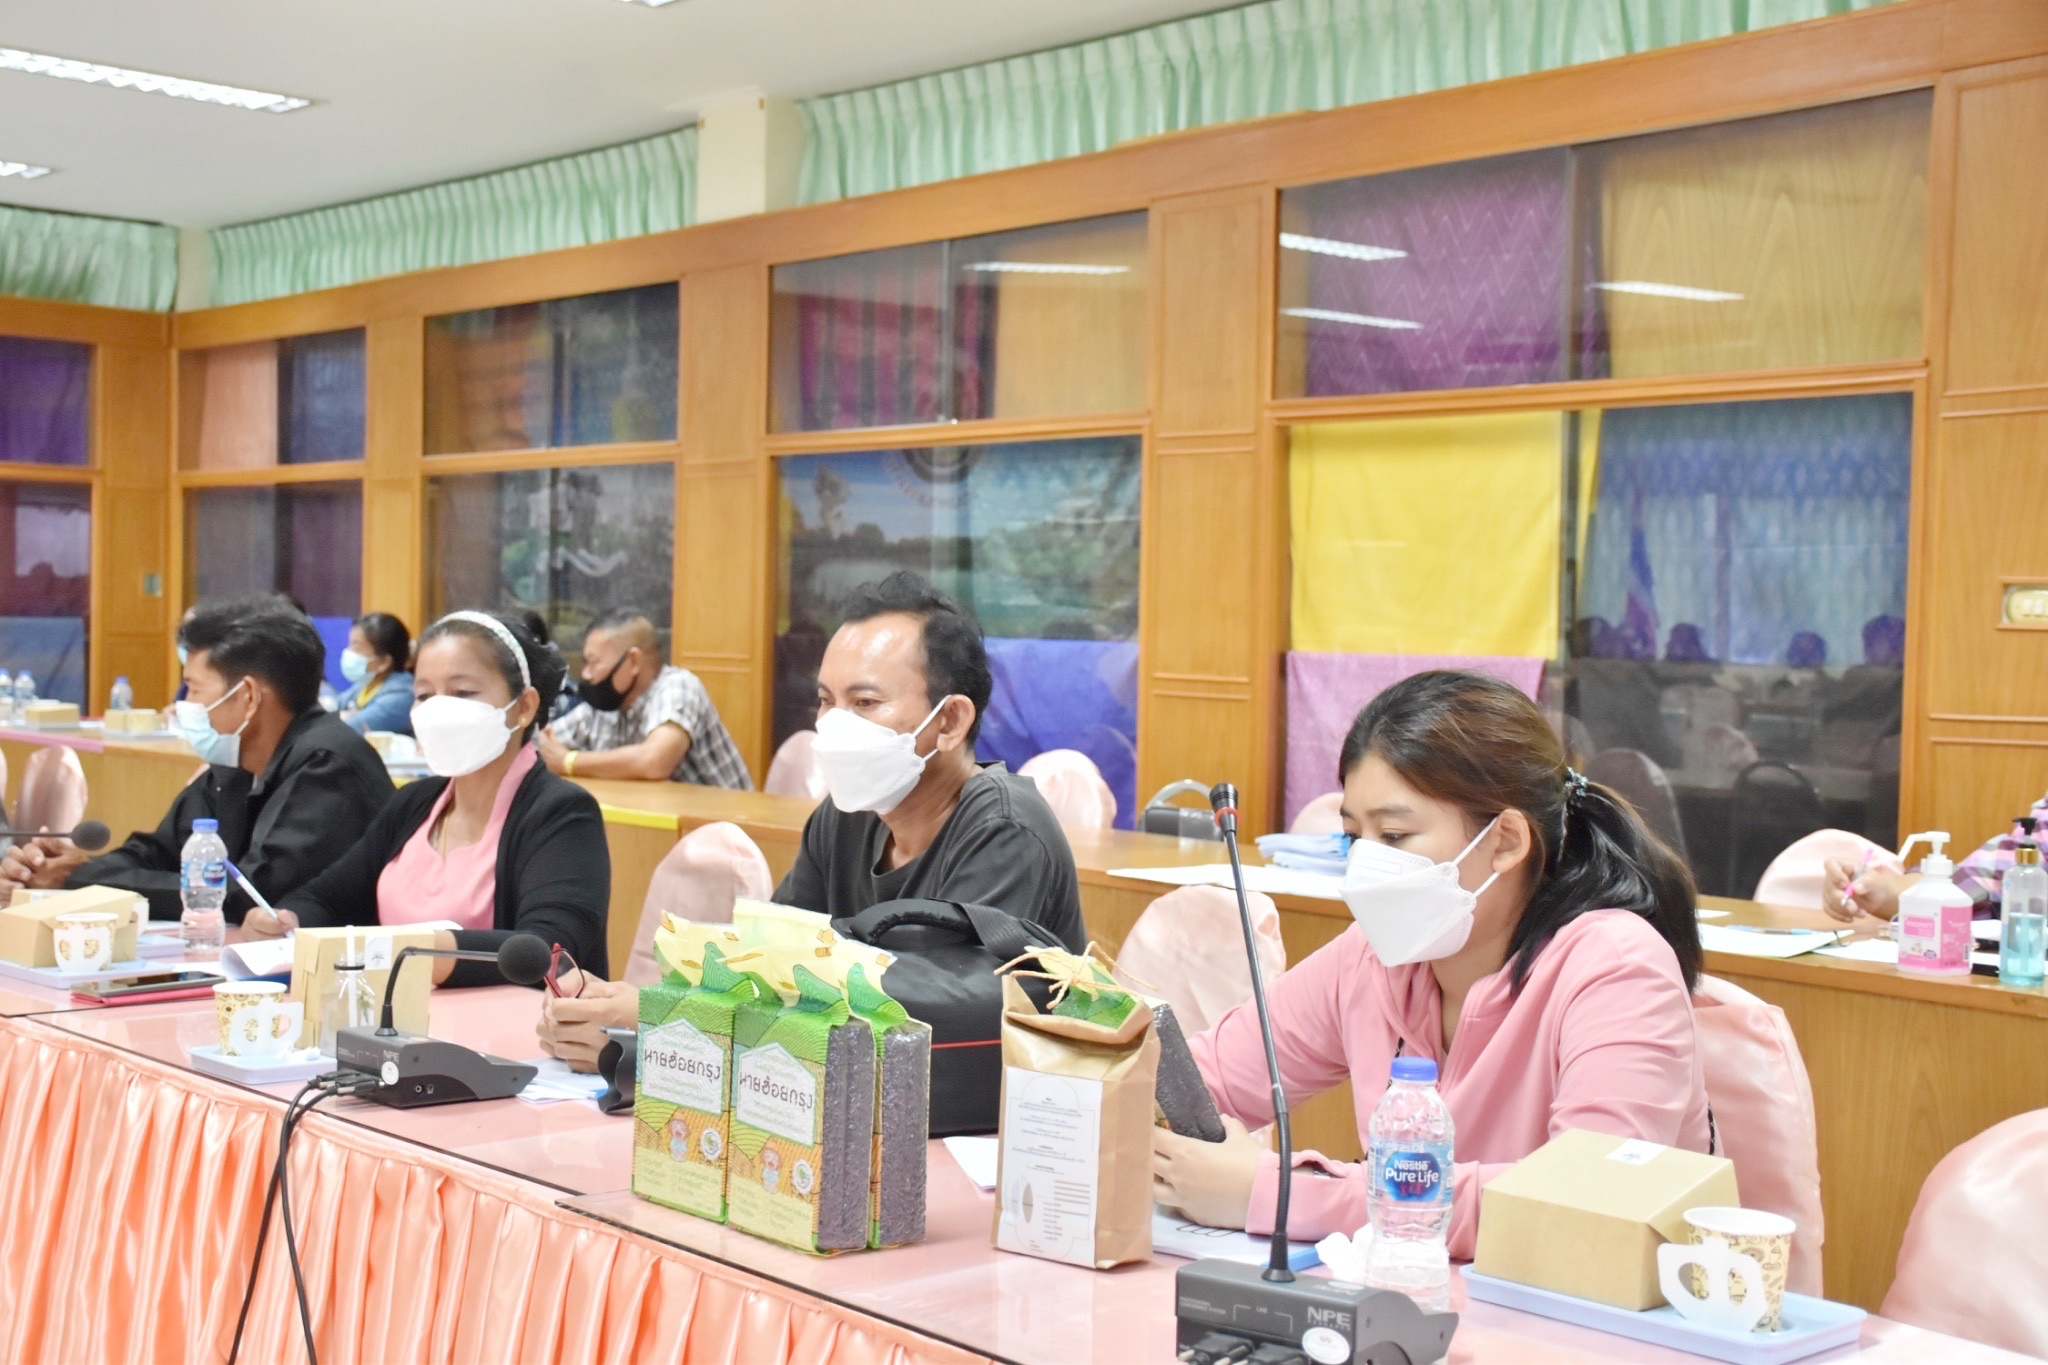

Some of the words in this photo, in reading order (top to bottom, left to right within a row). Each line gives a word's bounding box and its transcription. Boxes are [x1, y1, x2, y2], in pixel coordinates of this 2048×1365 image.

[1386, 1167, 1416, 1182] Pure
[1418, 1169, 1439, 1188] Life
[1307, 1306, 1351, 1327] NPE
